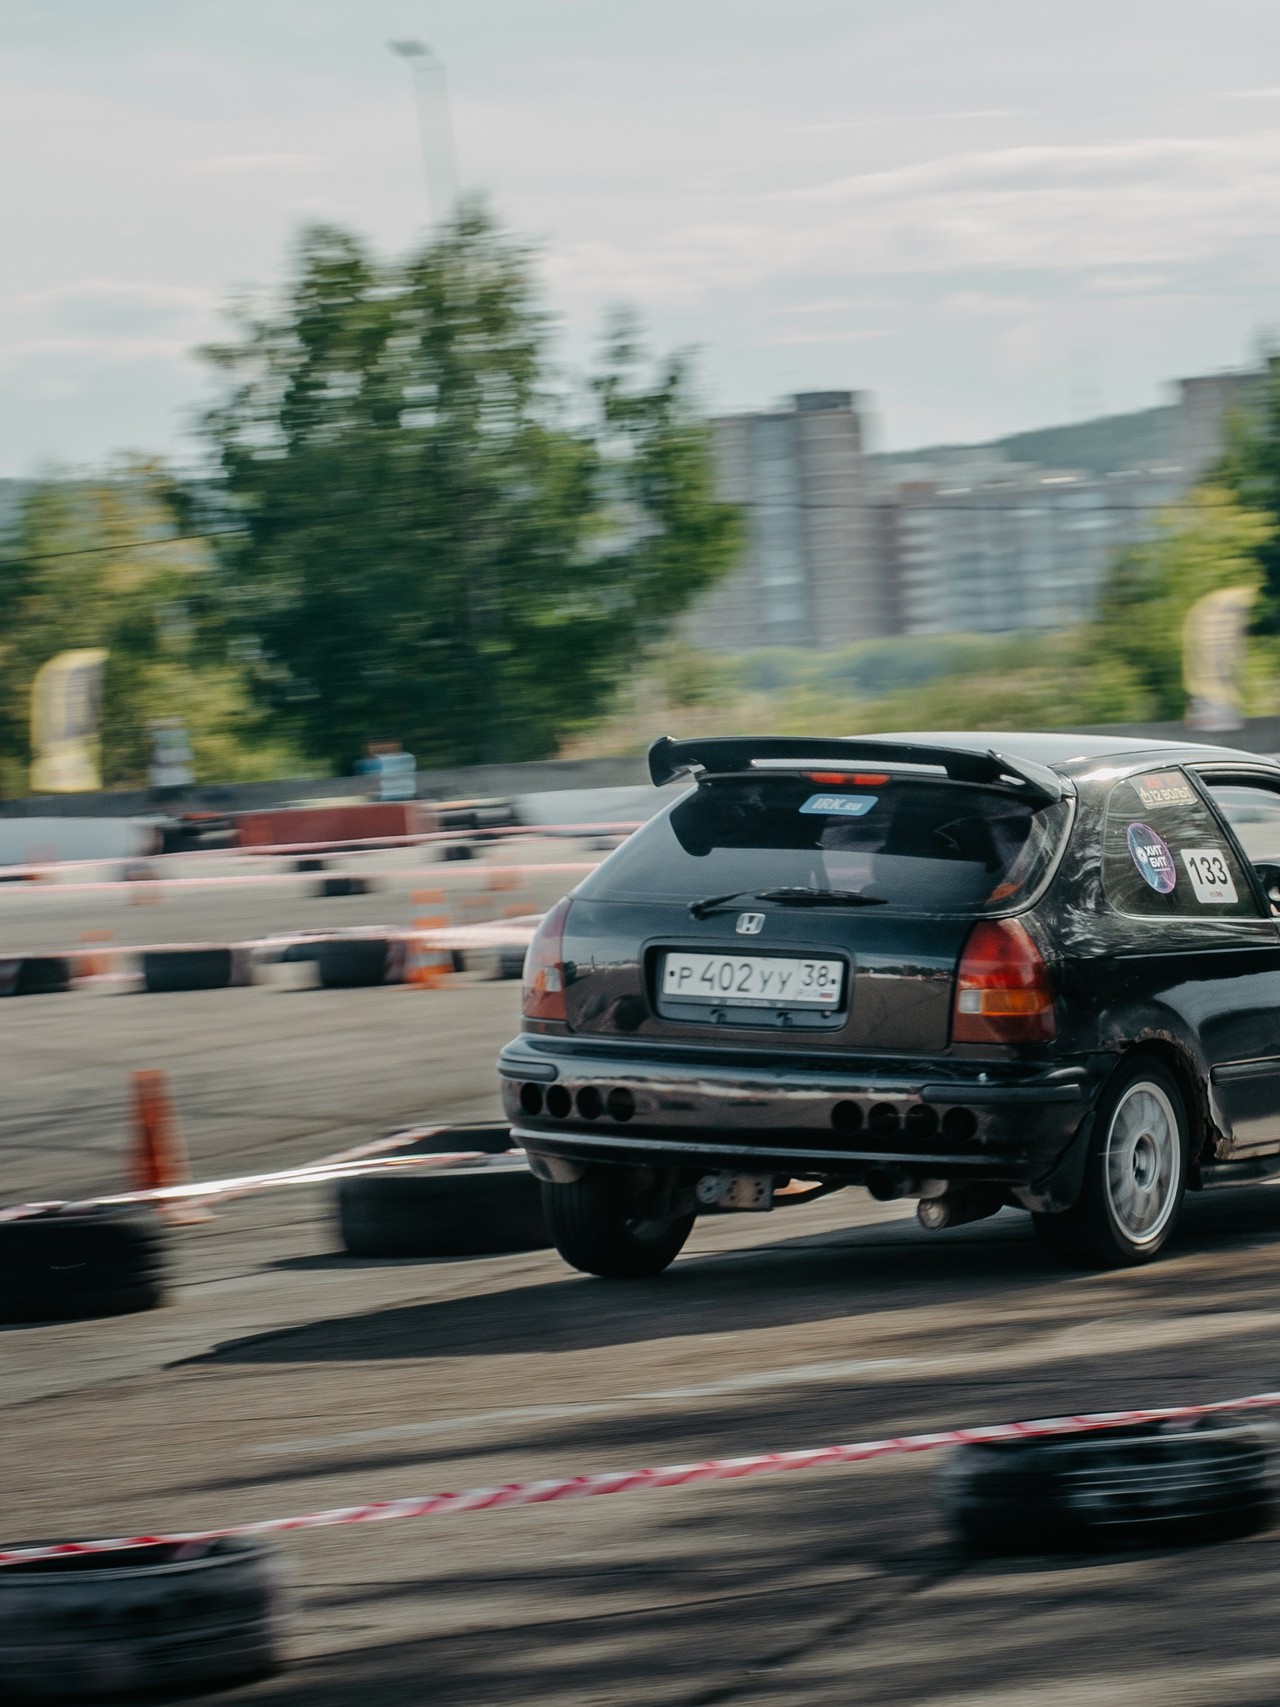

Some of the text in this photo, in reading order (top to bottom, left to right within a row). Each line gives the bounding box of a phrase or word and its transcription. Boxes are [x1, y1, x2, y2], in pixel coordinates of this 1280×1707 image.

[1150, 787, 1191, 801] 12 ВОЛЬТ
[1143, 845, 1163, 856] ХИТ
[1149, 856, 1167, 867] БИТ
[1188, 856, 1228, 885] 133
[802, 964, 830, 987] 38
